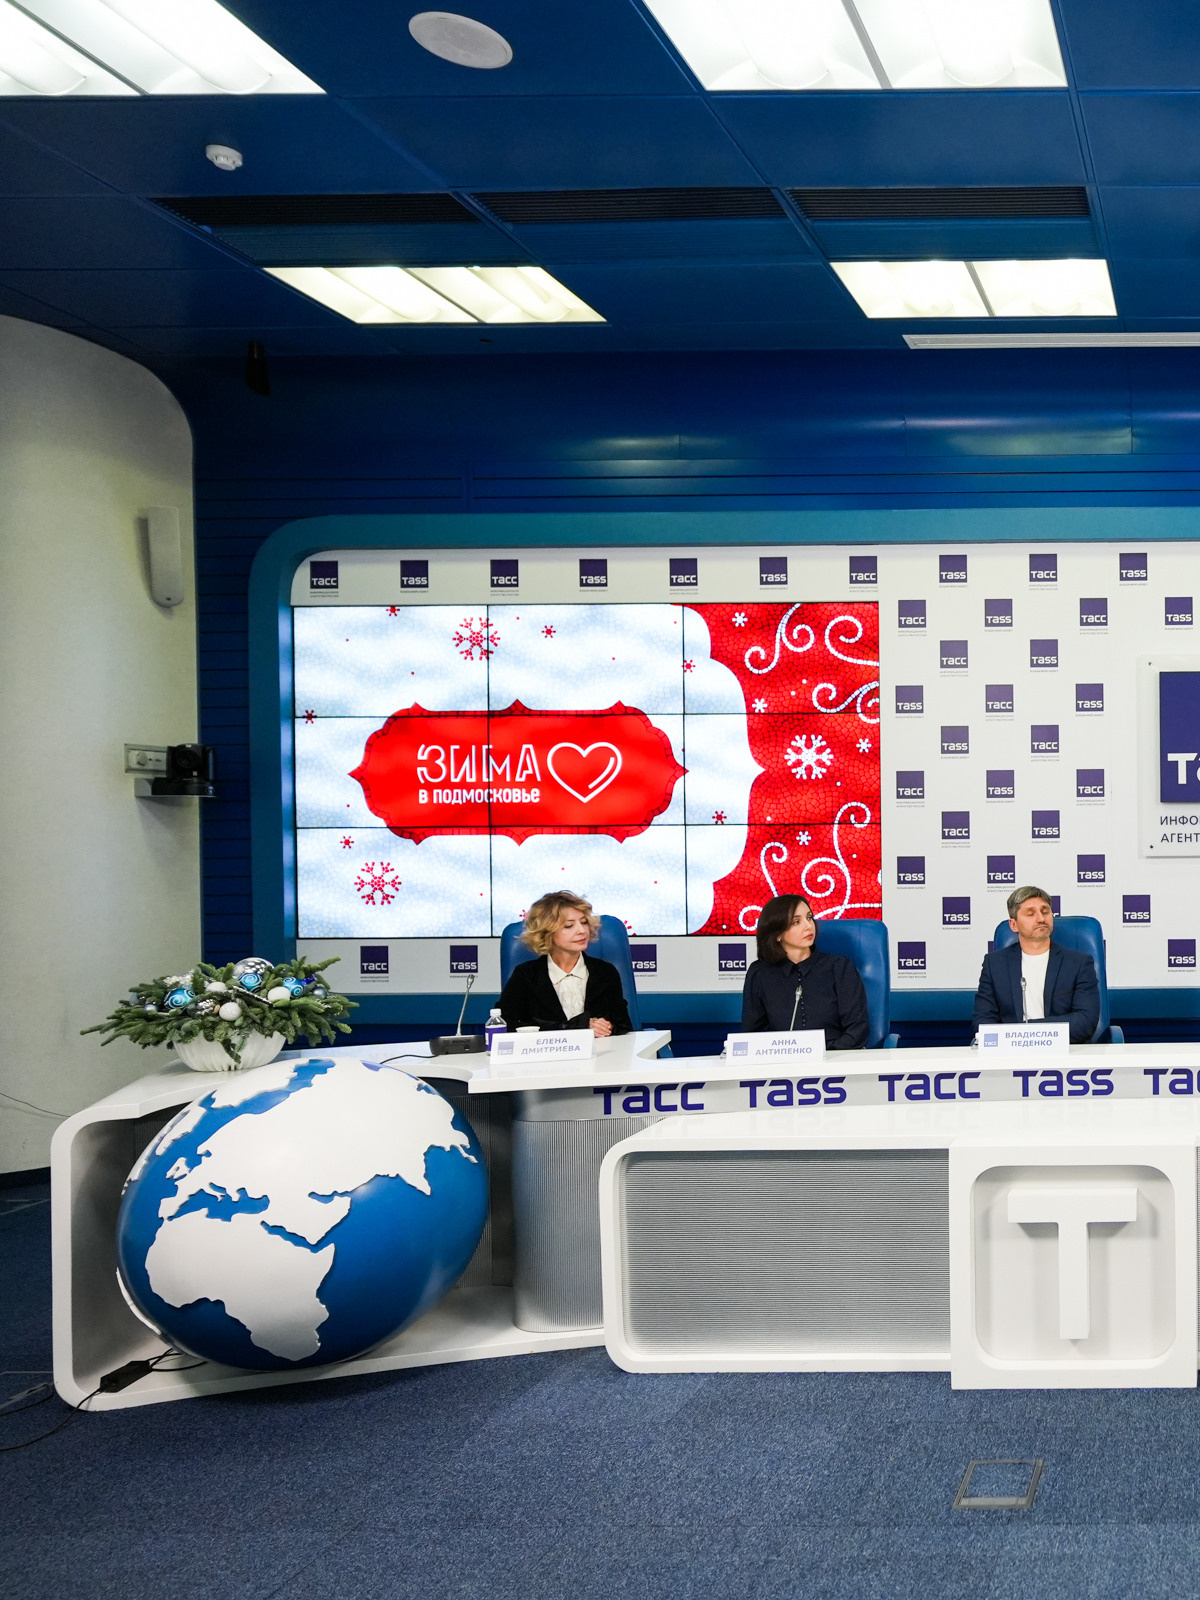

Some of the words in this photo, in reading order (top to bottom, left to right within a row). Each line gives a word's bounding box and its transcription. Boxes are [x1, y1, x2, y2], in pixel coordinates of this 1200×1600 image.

[1005, 1031, 1059, 1039] ВЛАДИСЛАВ
[536, 1037, 568, 1045] ЕЛЕНА
[1011, 1039, 1053, 1047] ПЕДЕНКО
[521, 1045, 581, 1055] ДМИТРИЕВА
[755, 1047, 812, 1056] АНТИПЕНКО
